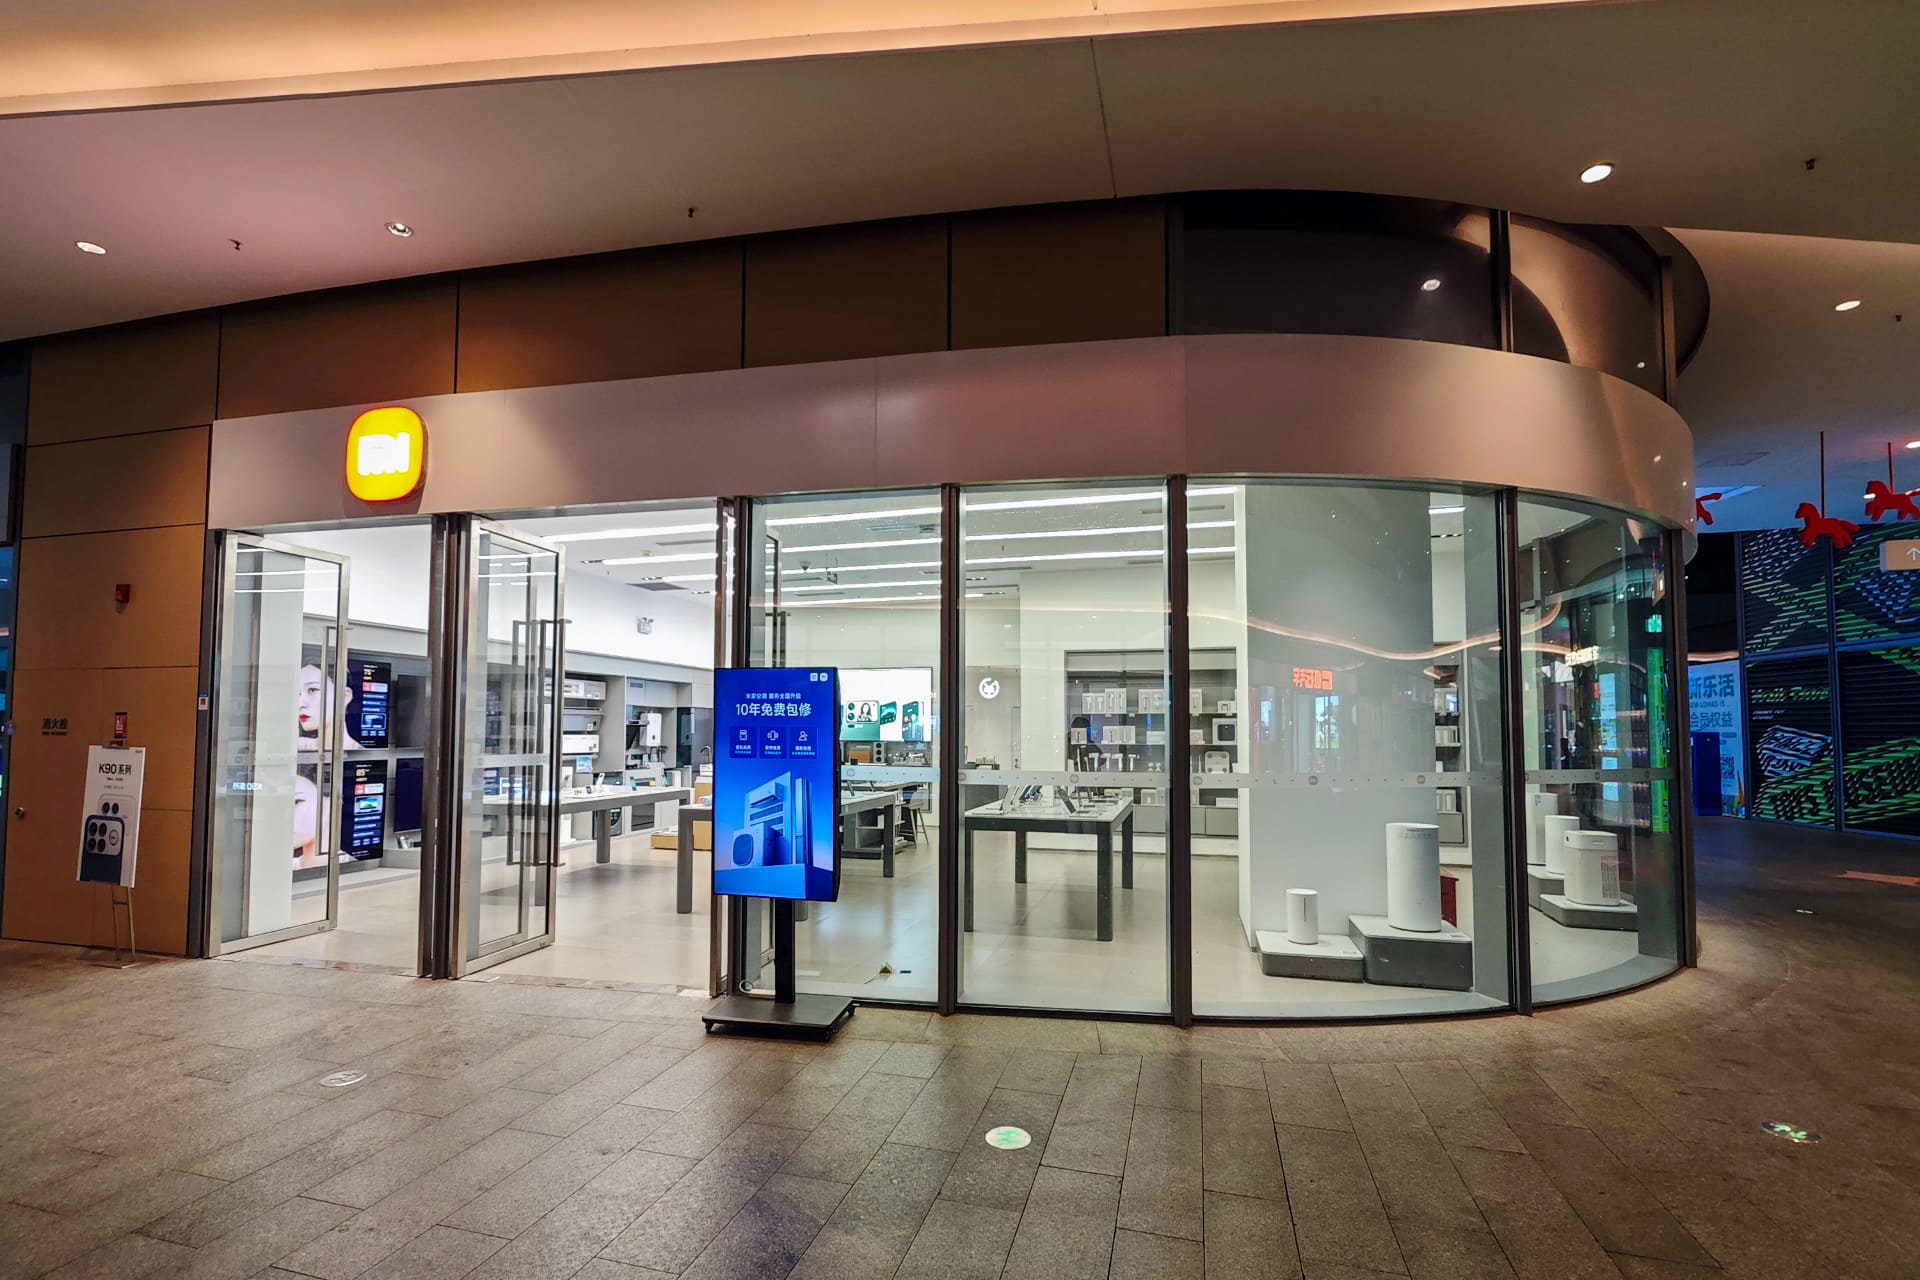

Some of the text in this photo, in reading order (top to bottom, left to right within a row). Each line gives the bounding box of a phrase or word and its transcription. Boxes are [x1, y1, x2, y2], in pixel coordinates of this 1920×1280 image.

[735, 702, 812, 717] 10年免费包修
[43, 718, 67, 730] 消火栓
[1689, 711, 1734, 728] 会员权益
[98, 763, 132, 776] K90 系列
